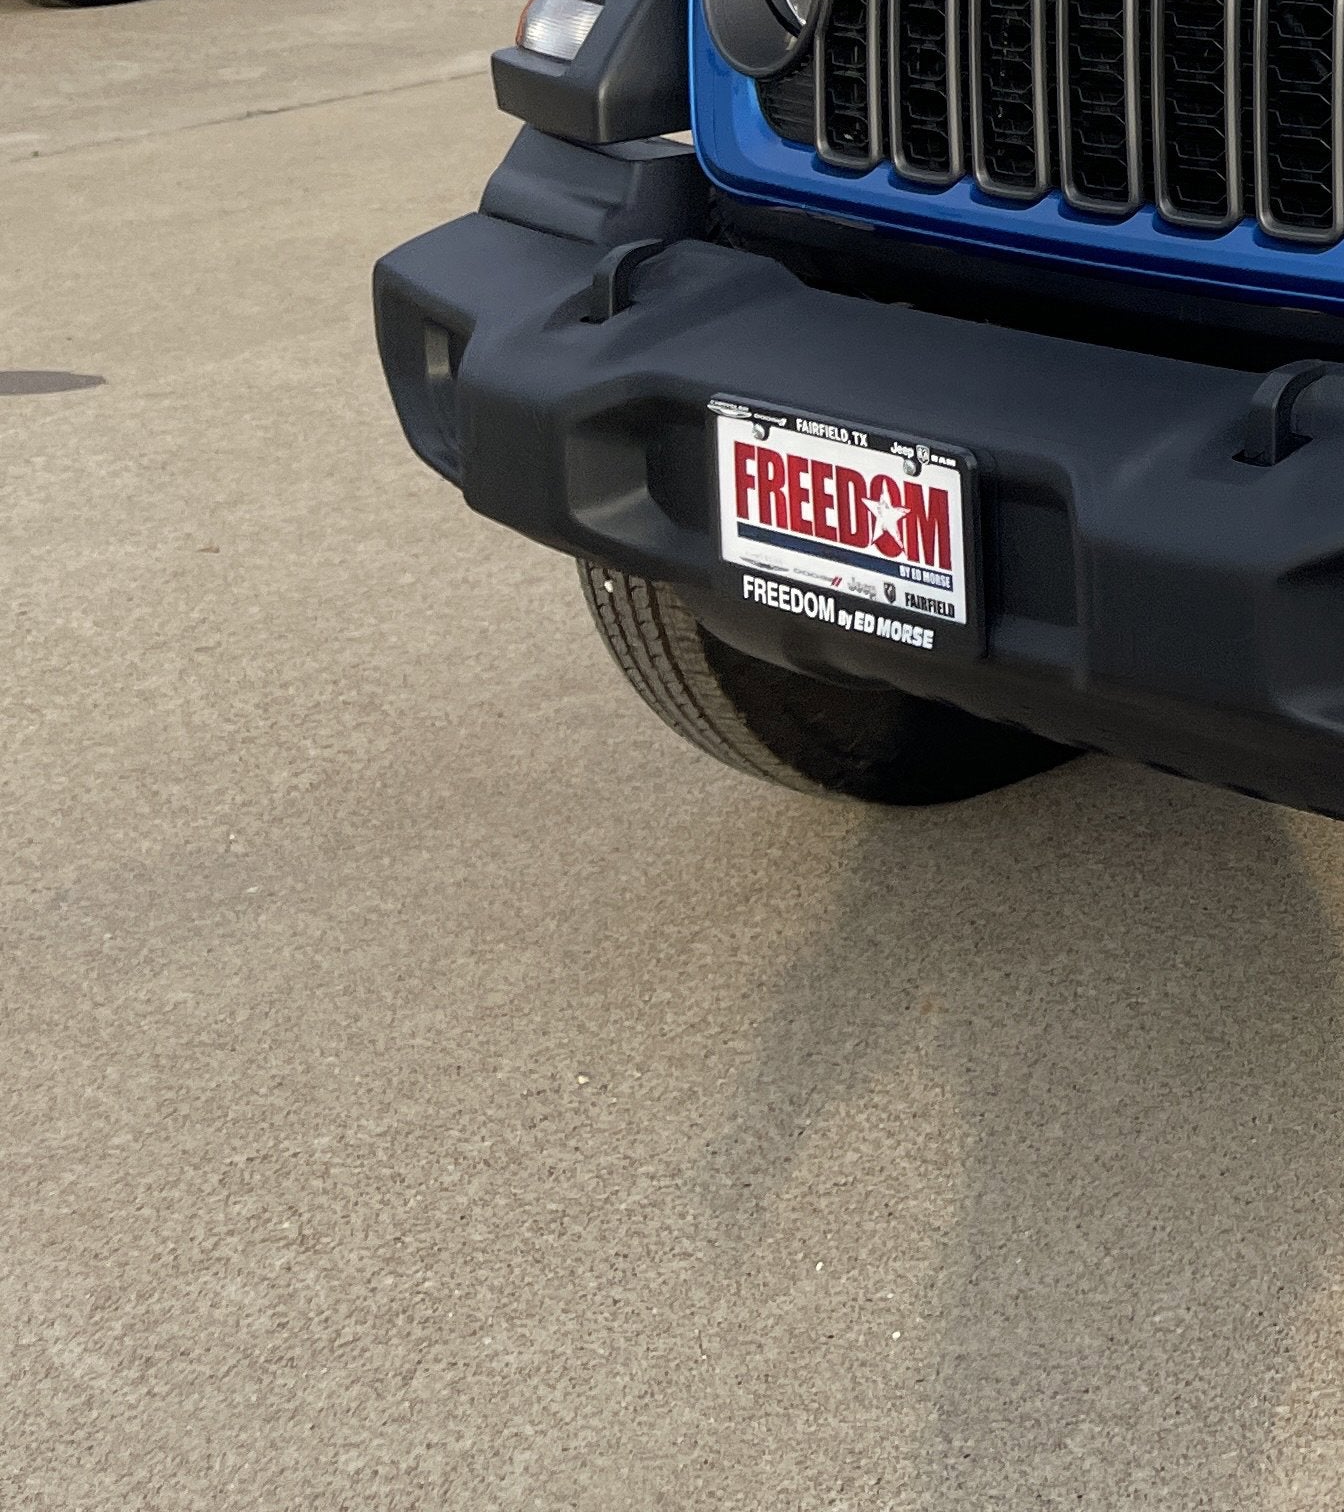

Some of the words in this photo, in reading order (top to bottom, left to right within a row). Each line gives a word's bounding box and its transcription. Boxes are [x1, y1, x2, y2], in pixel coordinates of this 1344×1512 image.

[796, 418, 850, 445] FAIRFIELD,
[852, 431, 868, 447] TX
[890, 442, 914, 458] Jeep
[734, 440, 953, 571] FREEDOM
[922, 570, 951, 589] MORSE
[743, 574, 835, 623] FREEDOM
[854, 610, 876, 634] ED
[876, 617, 934, 650] MORSE
[905, 592, 956, 618] FAIRFIELD
